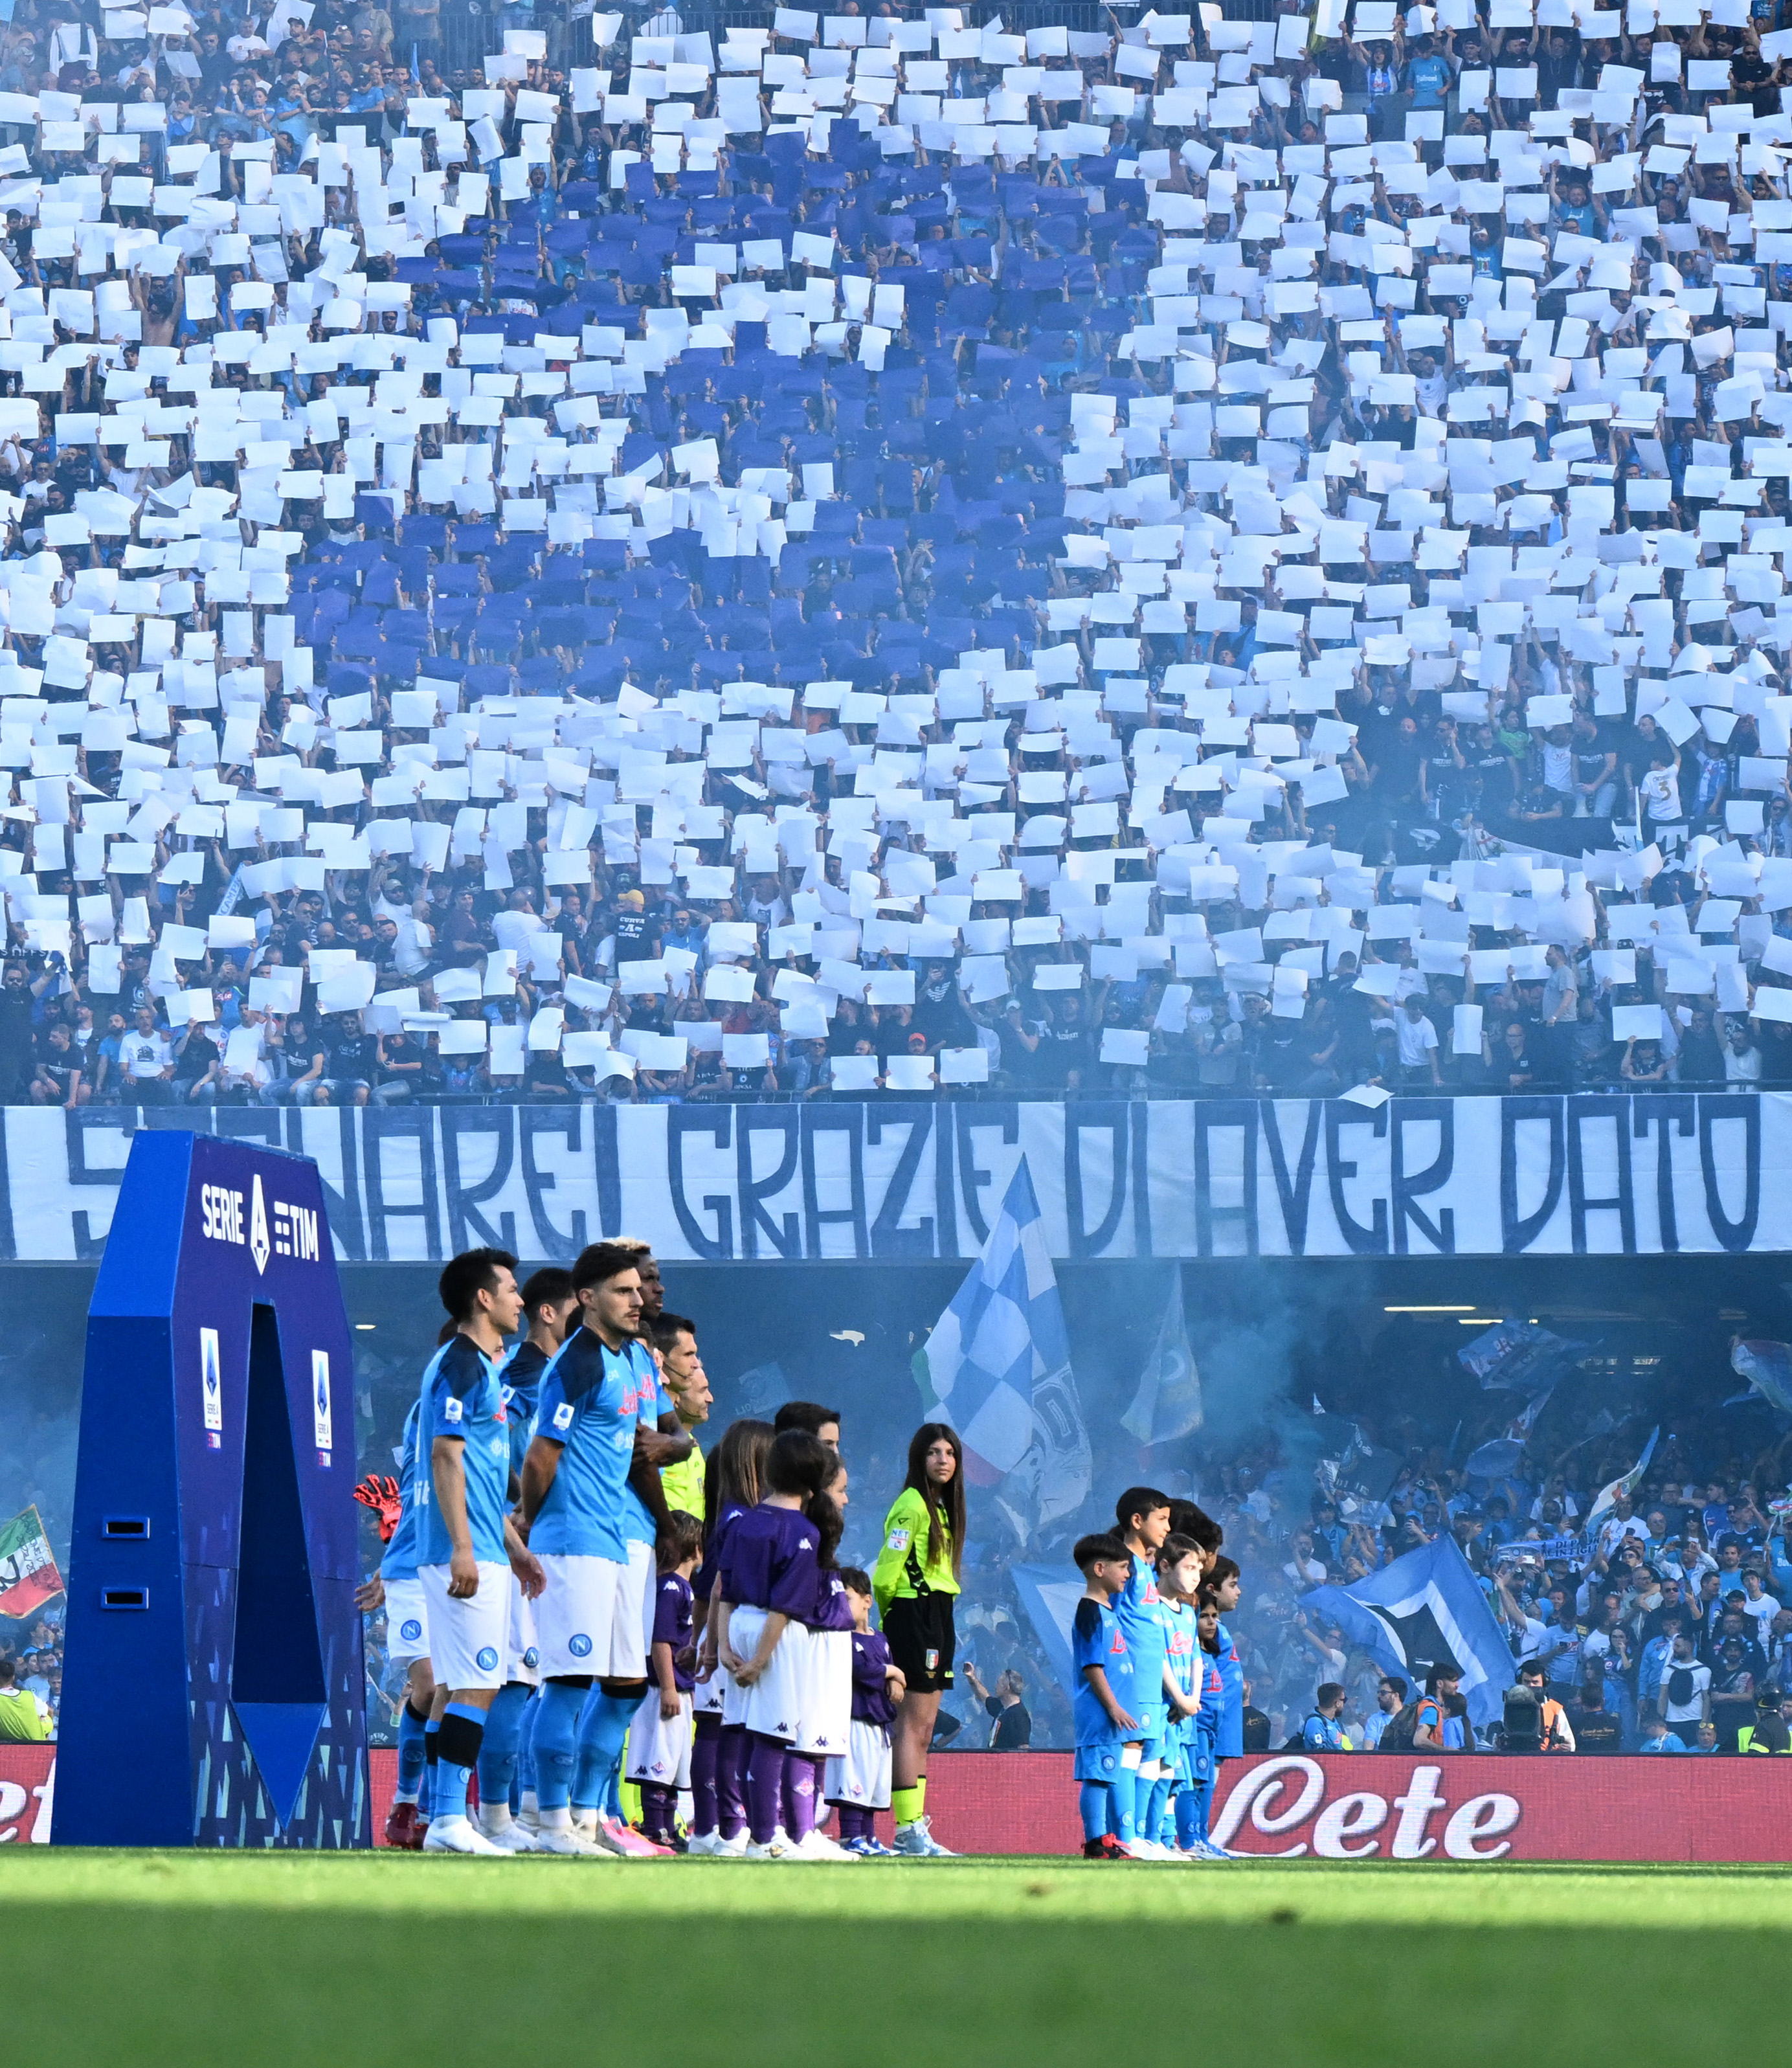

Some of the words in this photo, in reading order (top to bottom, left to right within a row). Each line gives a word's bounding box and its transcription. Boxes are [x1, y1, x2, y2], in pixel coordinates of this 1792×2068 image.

[1659, 781, 1672, 801] 3
[625, 924, 634, 932] A
[667, 1103, 1020, 1259] GRAZIE
[1065, 1101, 1152, 1258] DI
[1194, 1098, 1455, 1256] AVER
[1501, 1094, 1760, 1254] DATO
[202, 1183, 245, 1245] SERIE
[251, 1174, 270, 1276] A
[289, 1205, 319, 1262] TIM
